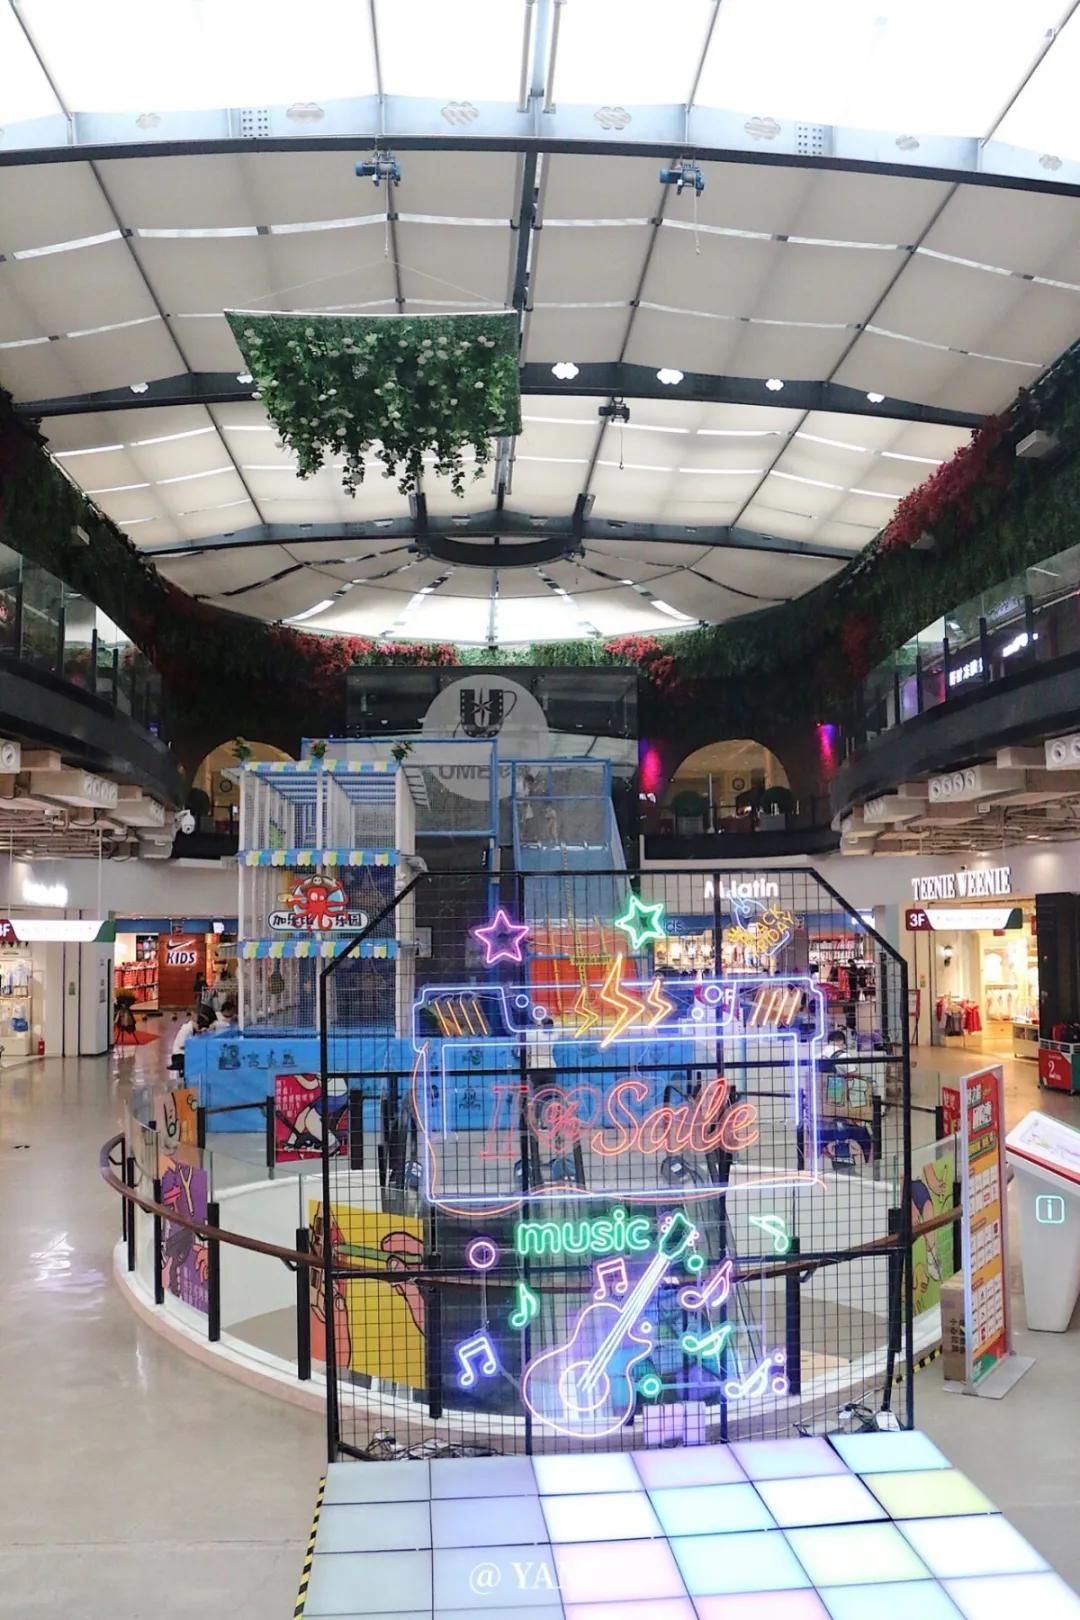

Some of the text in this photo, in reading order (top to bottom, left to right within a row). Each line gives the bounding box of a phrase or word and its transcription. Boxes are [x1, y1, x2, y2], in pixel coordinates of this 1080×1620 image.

[911, 873, 956, 901] TEENIE
[909, 913, 926, 927] 3F
[166, 951, 198, 965] KIDS
[590, 1077, 760, 1156] Sale
[517, 1208, 652, 1255] music
